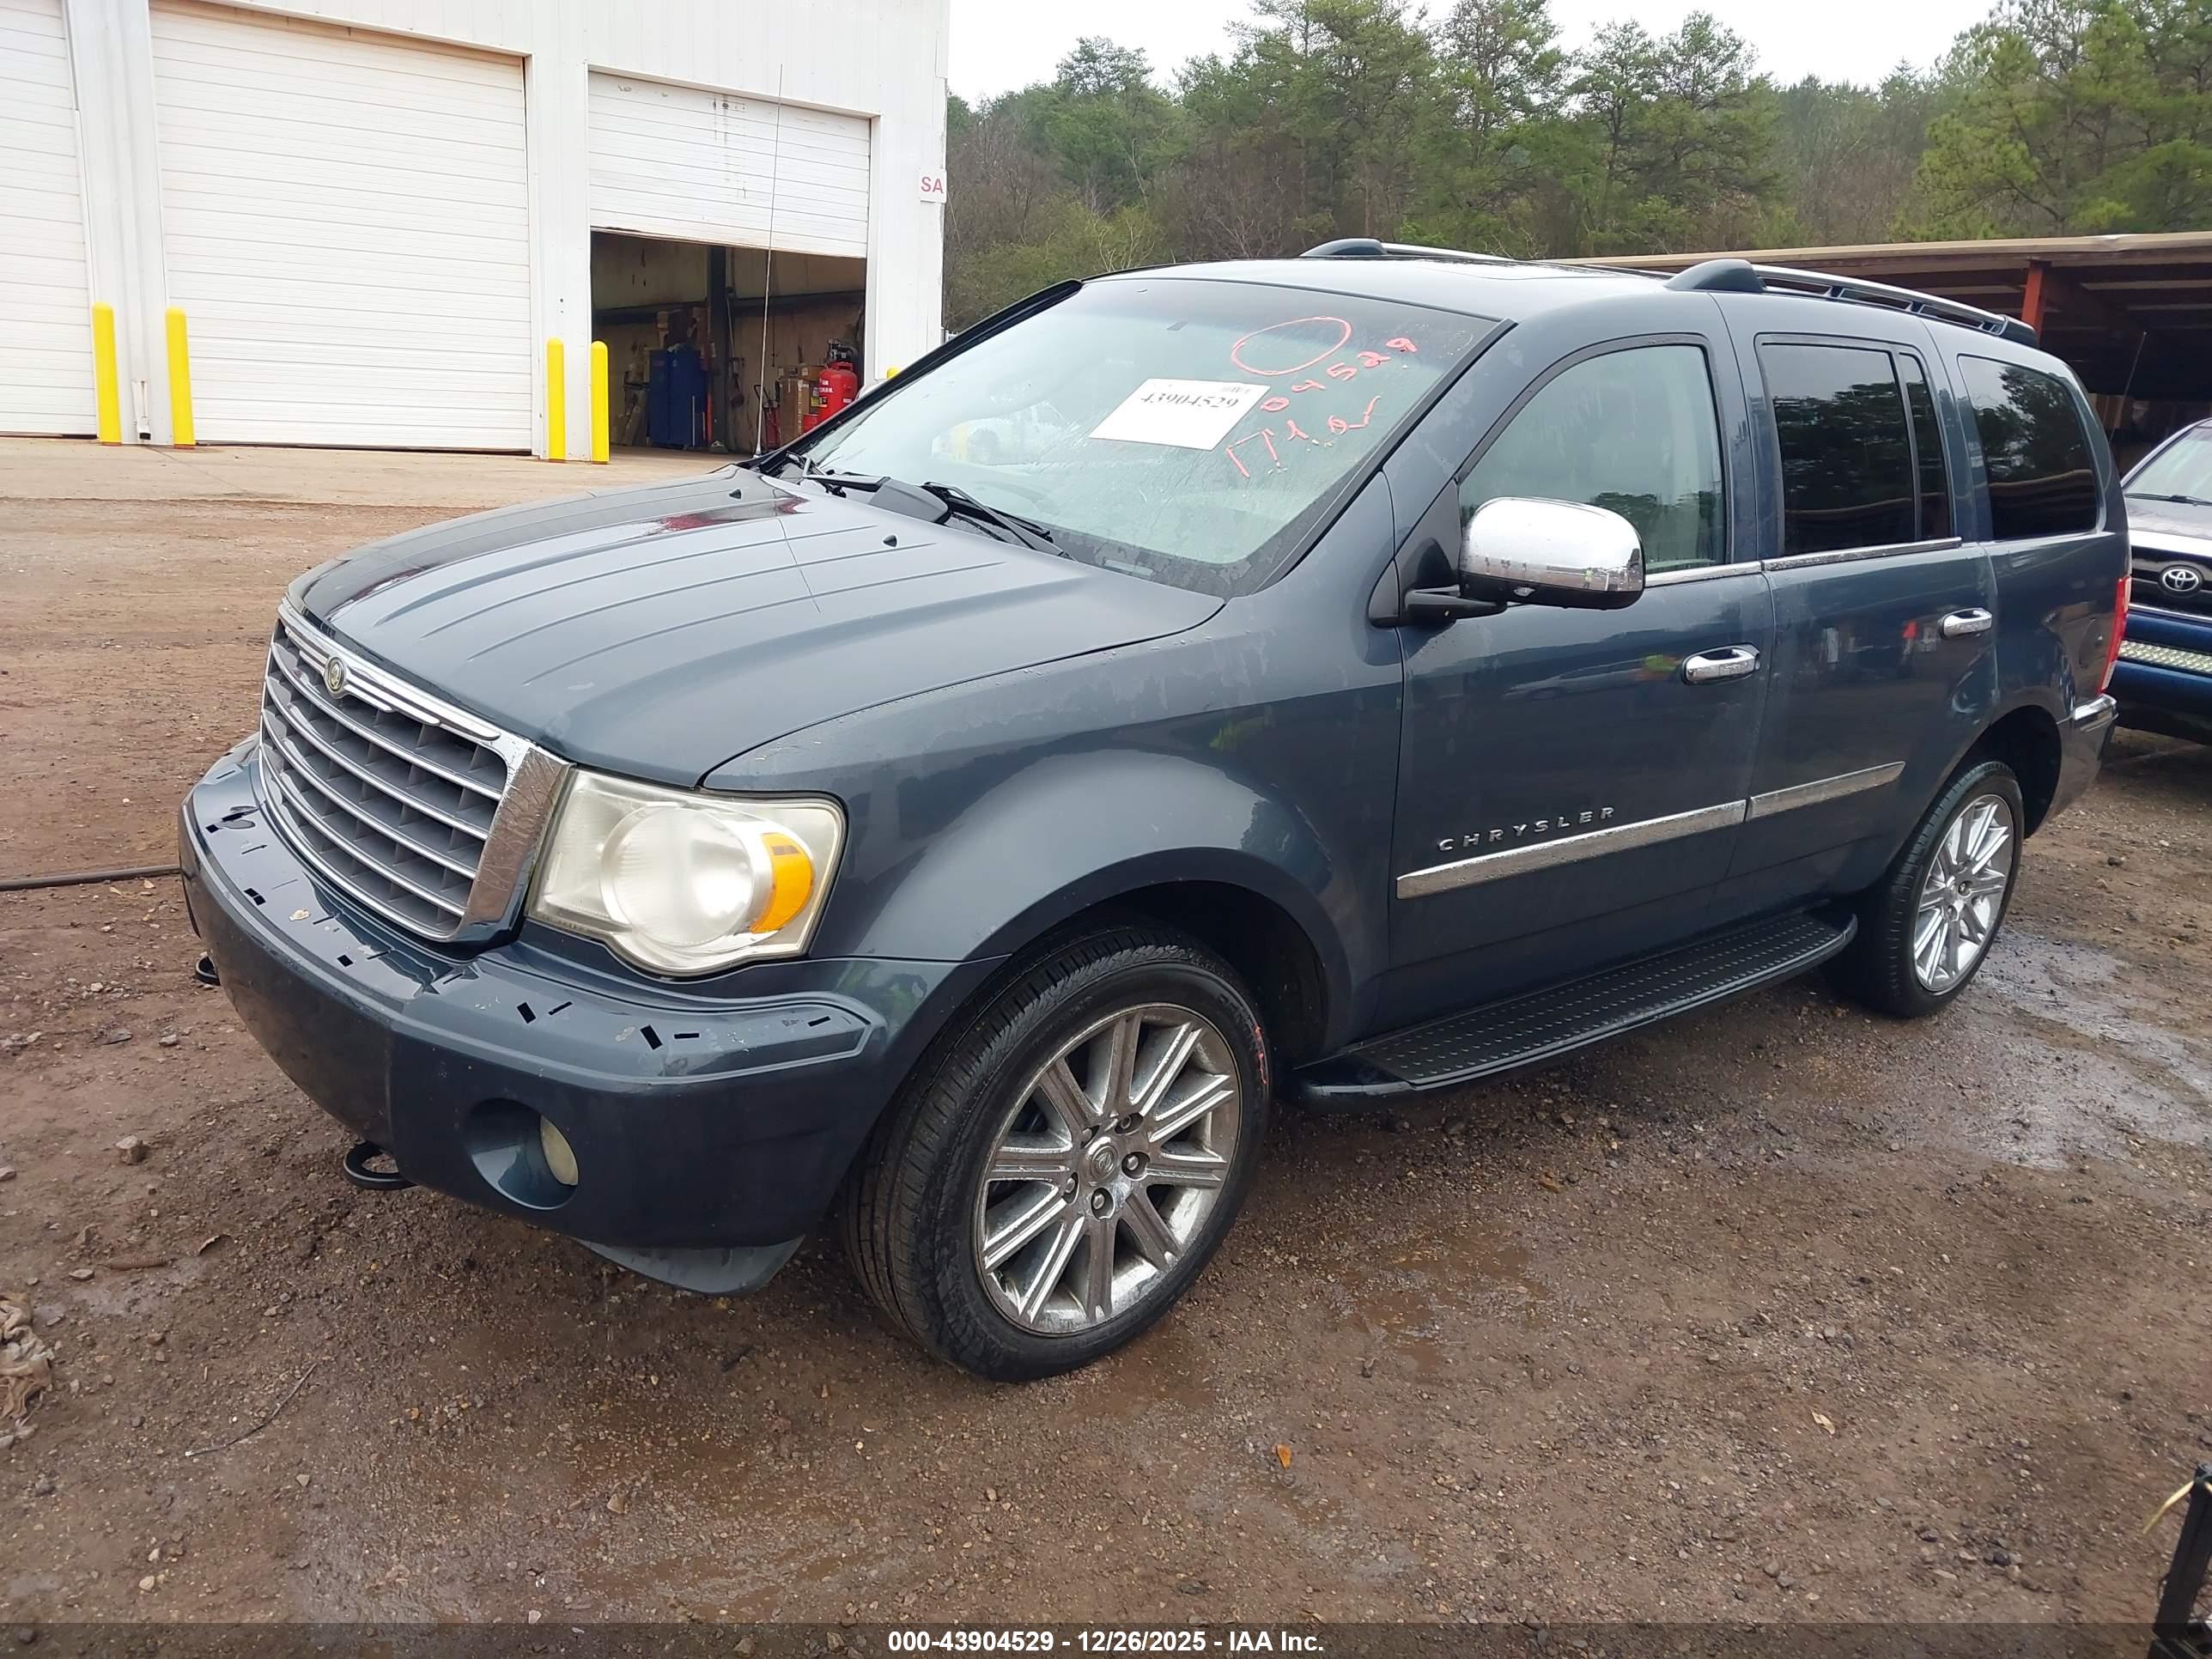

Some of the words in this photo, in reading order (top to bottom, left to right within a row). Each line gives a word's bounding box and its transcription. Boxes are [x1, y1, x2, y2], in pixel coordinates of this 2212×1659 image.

[921, 176, 945, 194] SA
[1140, 392, 1240, 409] 43904529
[1437, 806, 1615, 852] CHRYSLER
